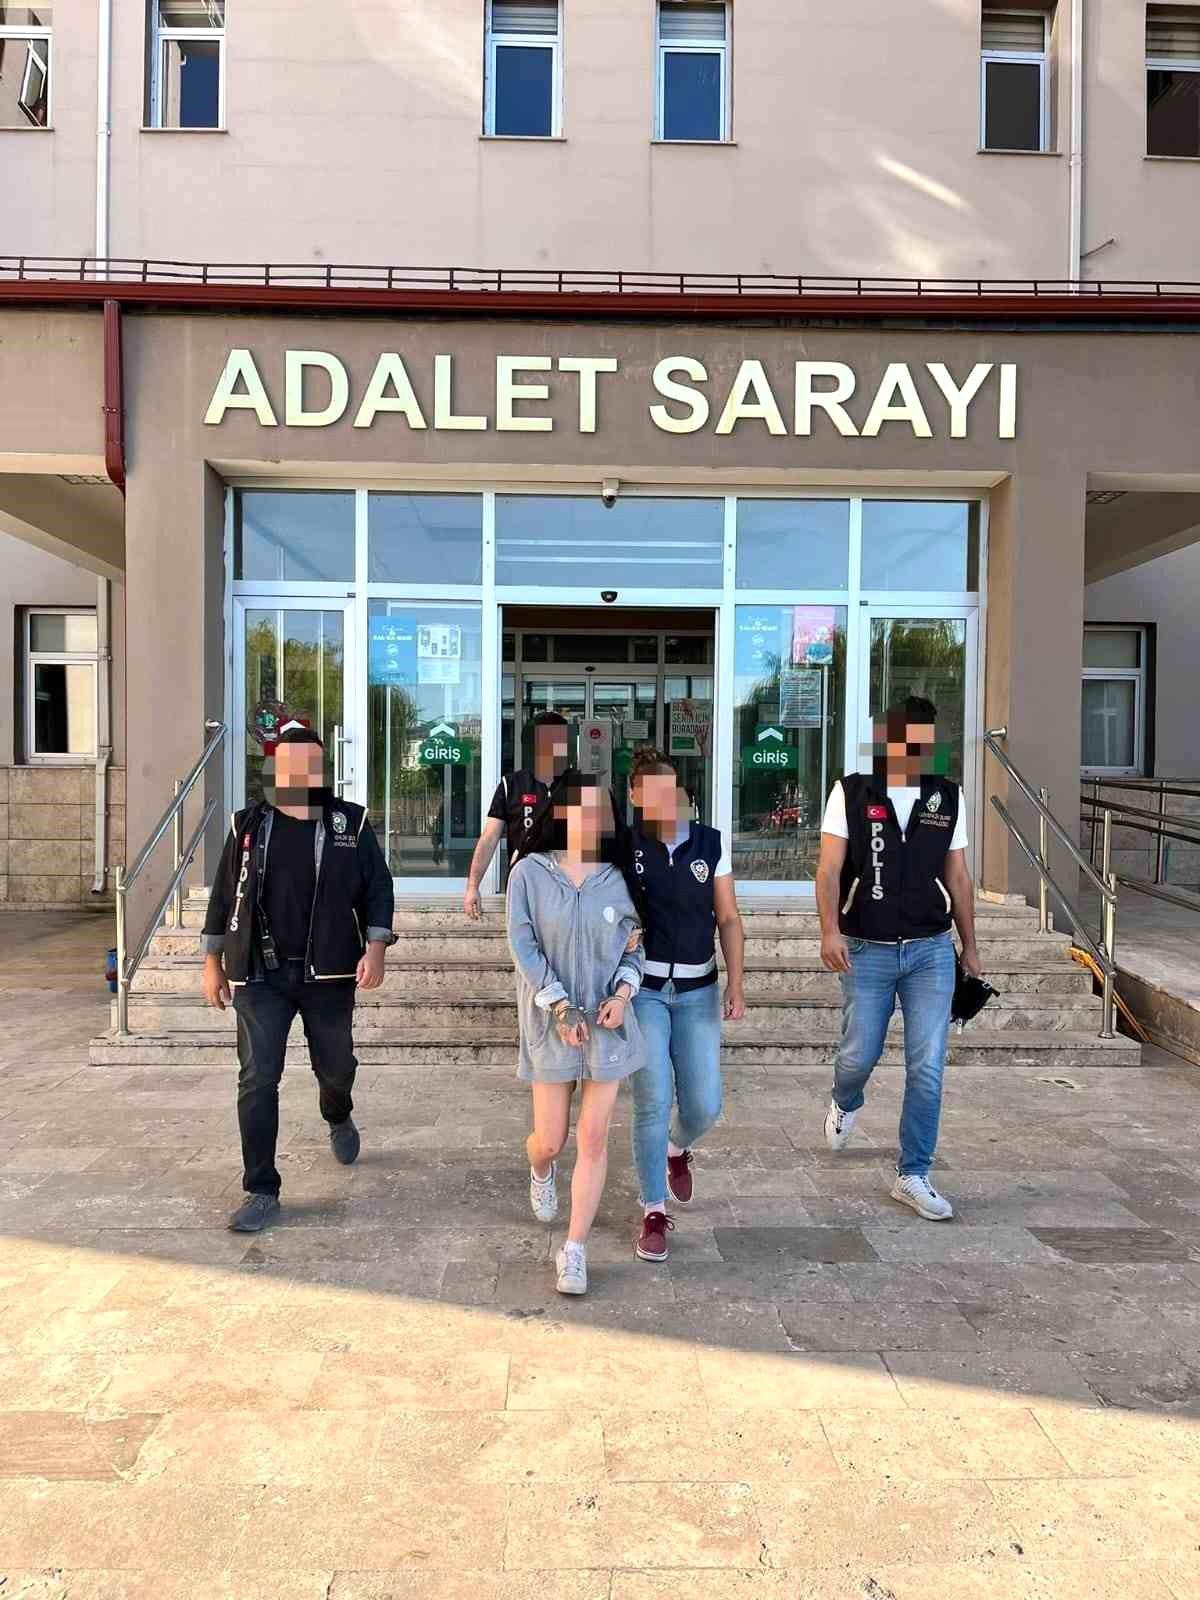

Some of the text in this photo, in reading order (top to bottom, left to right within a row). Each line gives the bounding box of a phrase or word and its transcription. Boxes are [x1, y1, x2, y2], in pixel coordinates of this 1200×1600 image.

[204, 348, 1018, 439] ADALET SARAYI
[424, 744, 461, 763] GİRİŞ
[752, 749, 789, 767] GİRİŞ
[870, 822, 885, 900] POLİS
